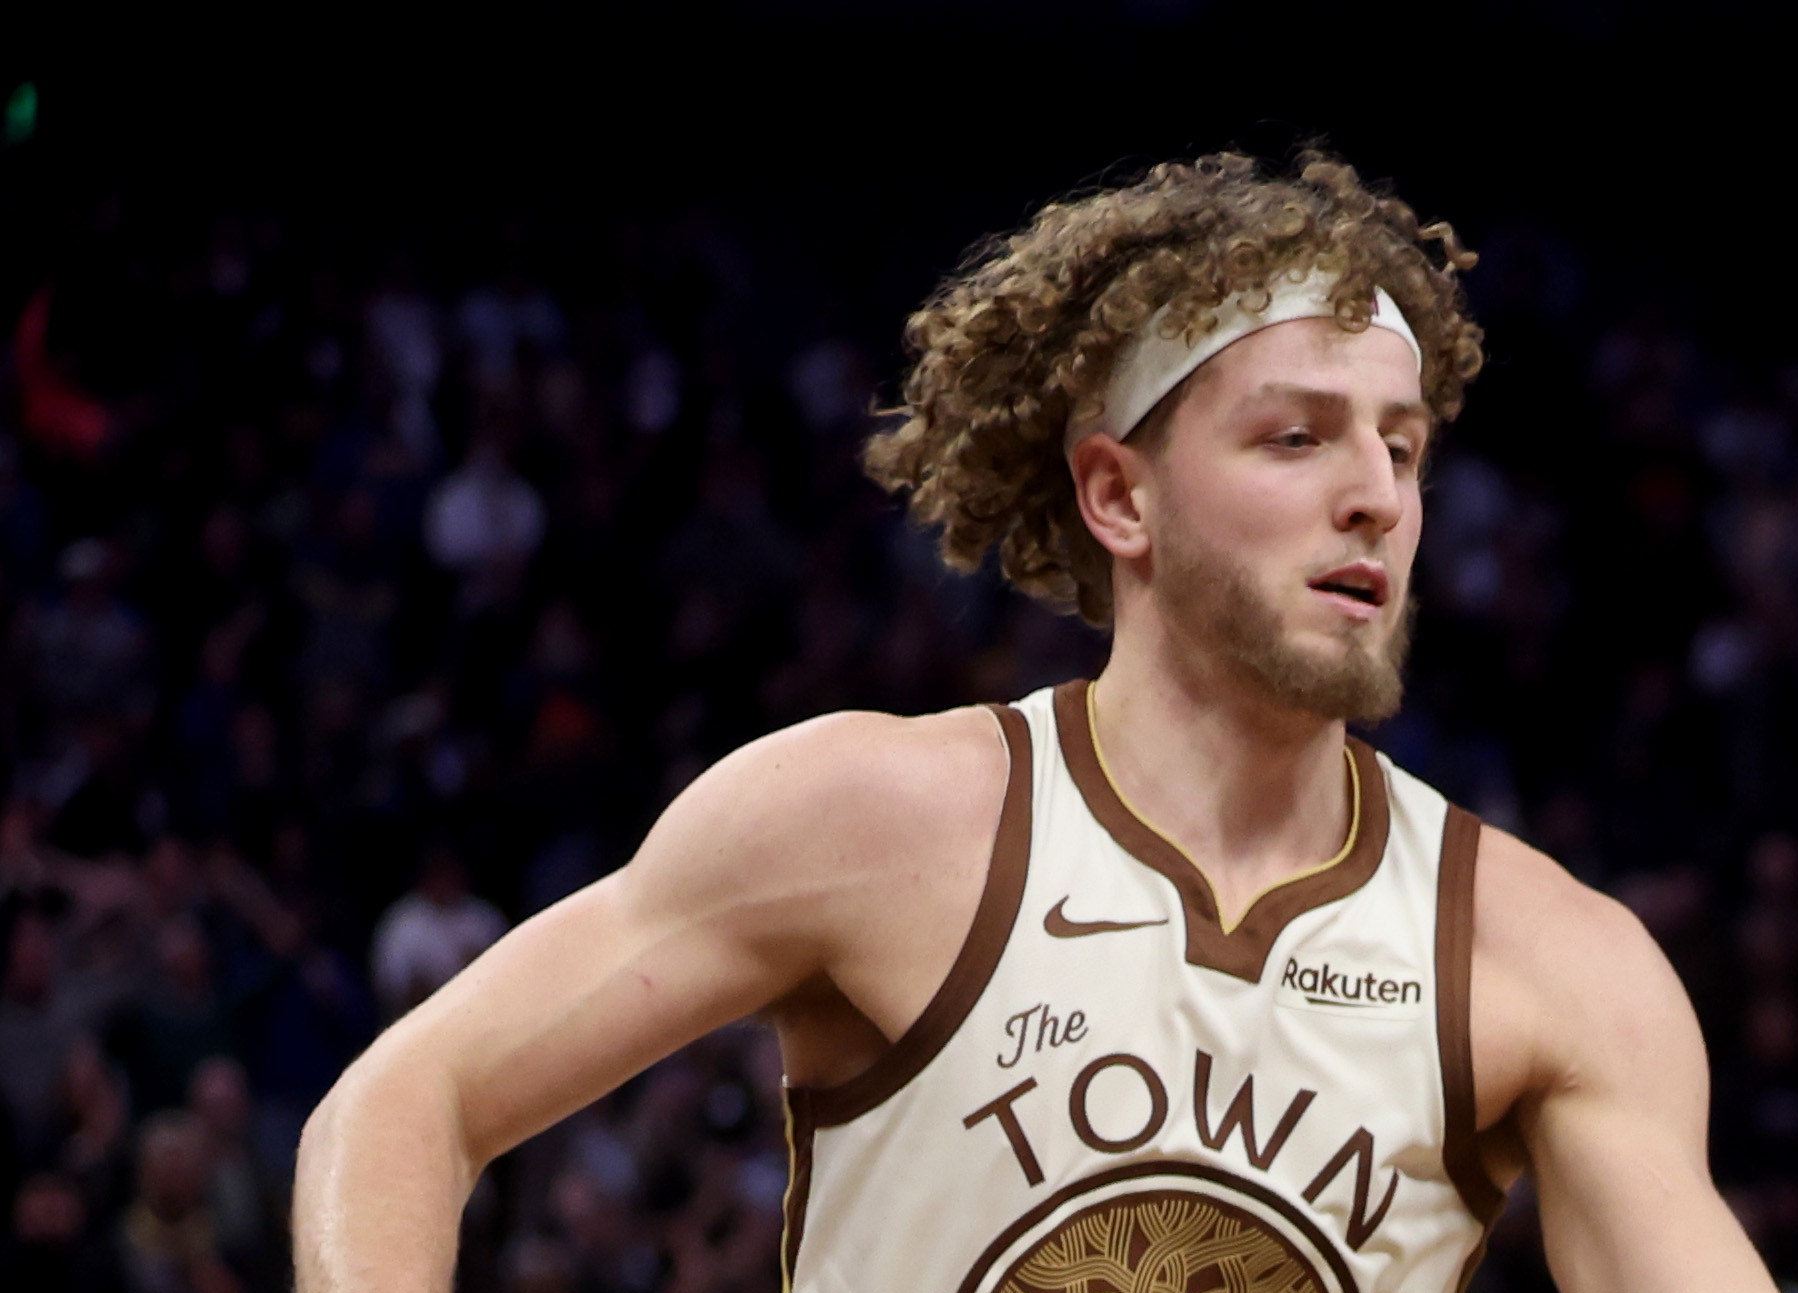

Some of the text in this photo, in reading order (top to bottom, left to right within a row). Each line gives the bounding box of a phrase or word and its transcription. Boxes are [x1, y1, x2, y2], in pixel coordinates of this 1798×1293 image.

[1281, 957, 1421, 1004] Rakuten
[996, 1003, 1088, 1068] The
[962, 1049, 1399, 1252] TOWN
